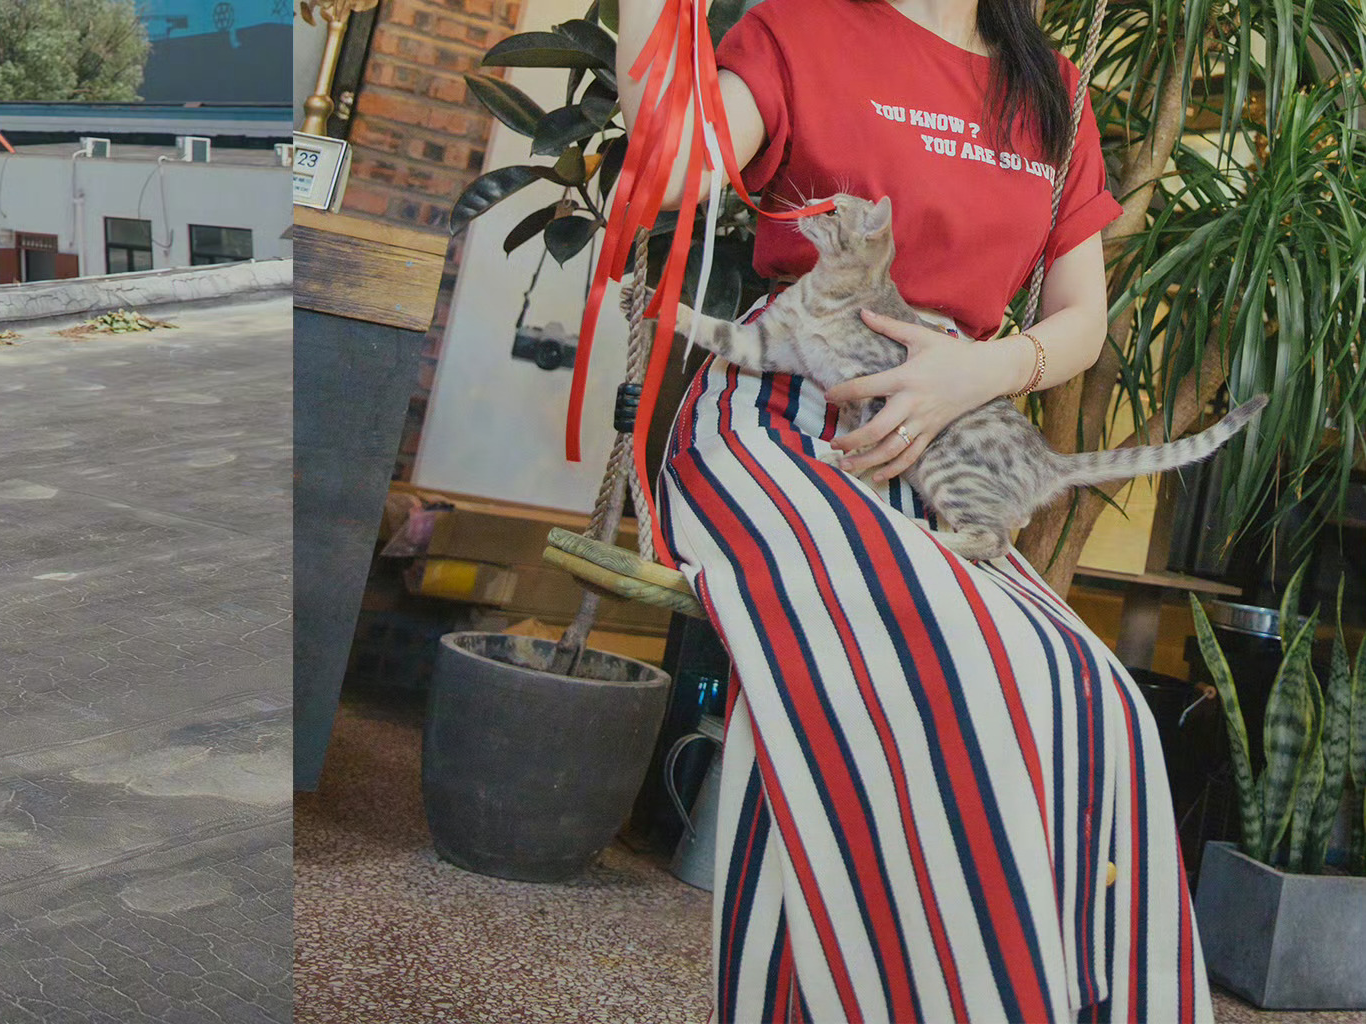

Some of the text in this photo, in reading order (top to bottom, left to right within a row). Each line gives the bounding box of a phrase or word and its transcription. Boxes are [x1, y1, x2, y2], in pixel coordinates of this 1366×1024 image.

[870, 99, 907, 123] YOU
[909, 109, 965, 134] KNOW
[297, 152, 319, 168] 23
[920, 134, 957, 157] YOU
[960, 141, 996, 166] ARE
[999, 151, 1022, 171] SO
